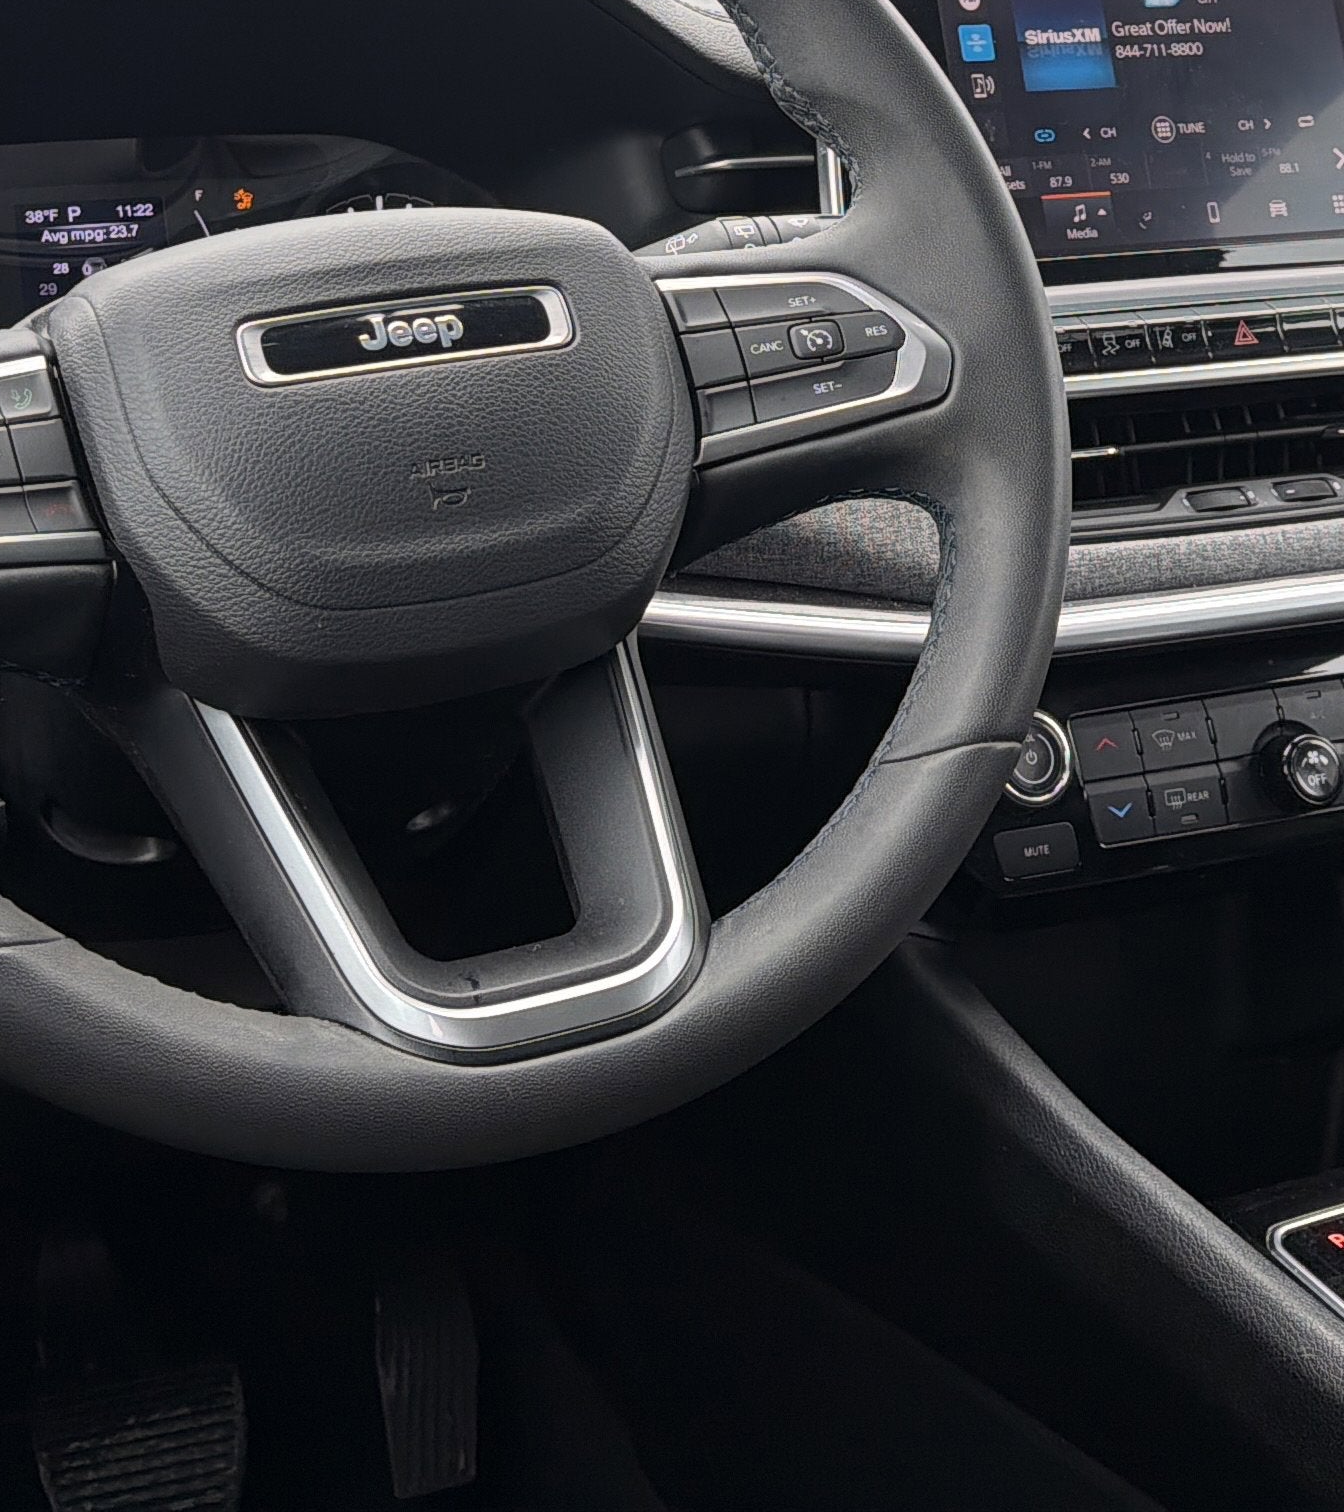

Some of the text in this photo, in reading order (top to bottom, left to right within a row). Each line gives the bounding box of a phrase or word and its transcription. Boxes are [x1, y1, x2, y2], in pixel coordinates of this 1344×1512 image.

[1111, 17, 1232, 37] Great Offer Now!
[1024, 27, 1102, 45] SiriusXM
[1115, 42, 1204, 59] 844-711-8800
[1177, 122, 1205, 135] TUNE
[1238, 120, 1254, 130] CH
[1100, 126, 1117, 138] CH
[1090, 158, 1112, 168] 2-AM
[1221, 152, 1256, 164] Hold to
[1031, 161, 1053, 171] 1-FM
[1230, 166, 1253, 177] Save
[1279, 163, 1299, 174] 88.1
[1049, 176, 1073, 188] 87.9
[1110, 173, 1131, 184] 530
[194, 189, 204, 202] F
[25, 203, 154, 224] 38°F P 11:22
[41, 224, 139, 245] Avg mpg: 23.7
[1067, 227, 1098, 240] Media
[53, 262, 70, 275] 28
[39, 282, 58, 296] 29
[358, 313, 464, 352] Jeep
[865, 325, 888, 338] RES
[1182, 332, 1197, 342] OFF
[750, 340, 784, 355] CANC
[1125, 339, 1141, 349] OFF
[409, 454, 486, 479] AIRBAG
[1176, 730, 1198, 741] MAX
[1307, 773, 1327, 787] OFF
[1187, 789, 1210, 803] REAR
[1024, 844, 1050, 858] MUTE
